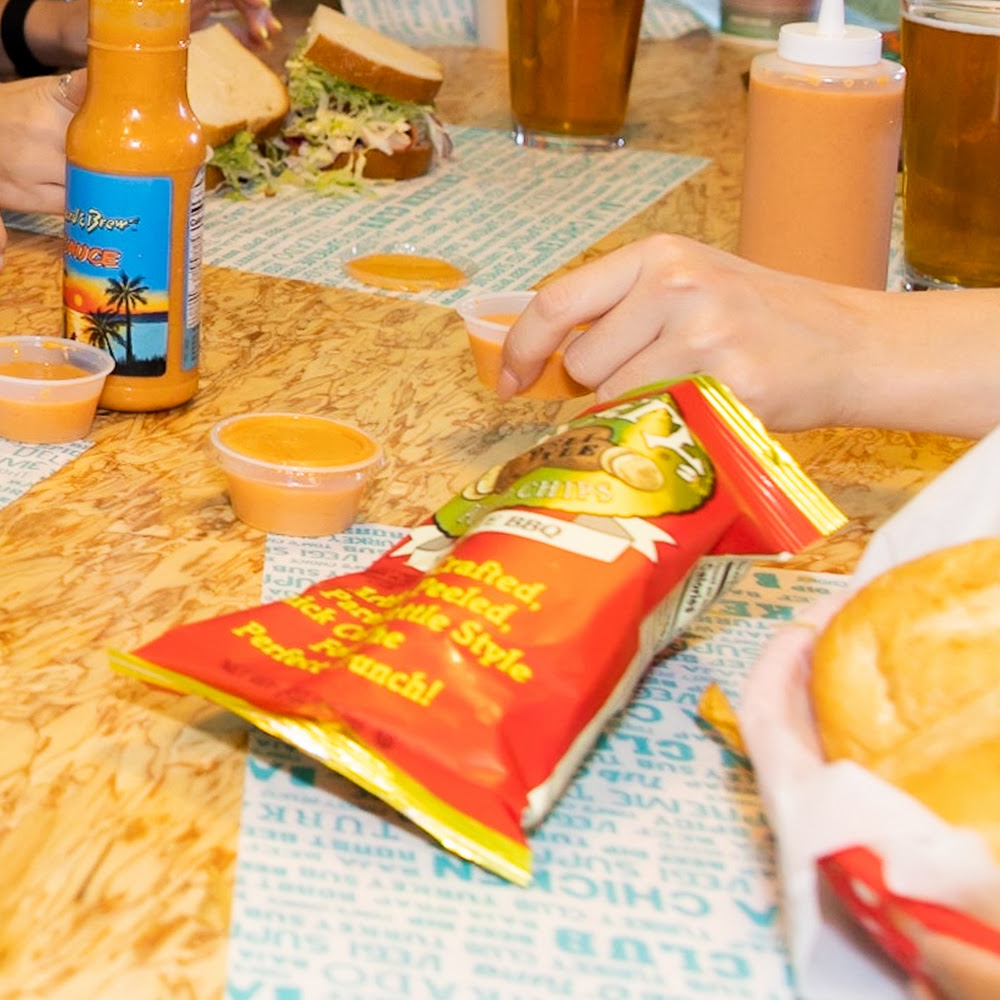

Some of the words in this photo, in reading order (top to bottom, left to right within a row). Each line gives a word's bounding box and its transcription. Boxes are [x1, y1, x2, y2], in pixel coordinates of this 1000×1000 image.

[516, 479, 614, 504] CHIPS
[328, 534, 394, 549] URKEY
[503, 514, 563, 539] BBQ
[299, 548, 358, 563] VEGI
[442, 556, 547, 611] rafted,
[422, 578, 519, 633] eeled,
[451, 620, 533, 683] Style
[258, 804, 402, 841] TURK
[555, 928, 752, 981] CLUB
